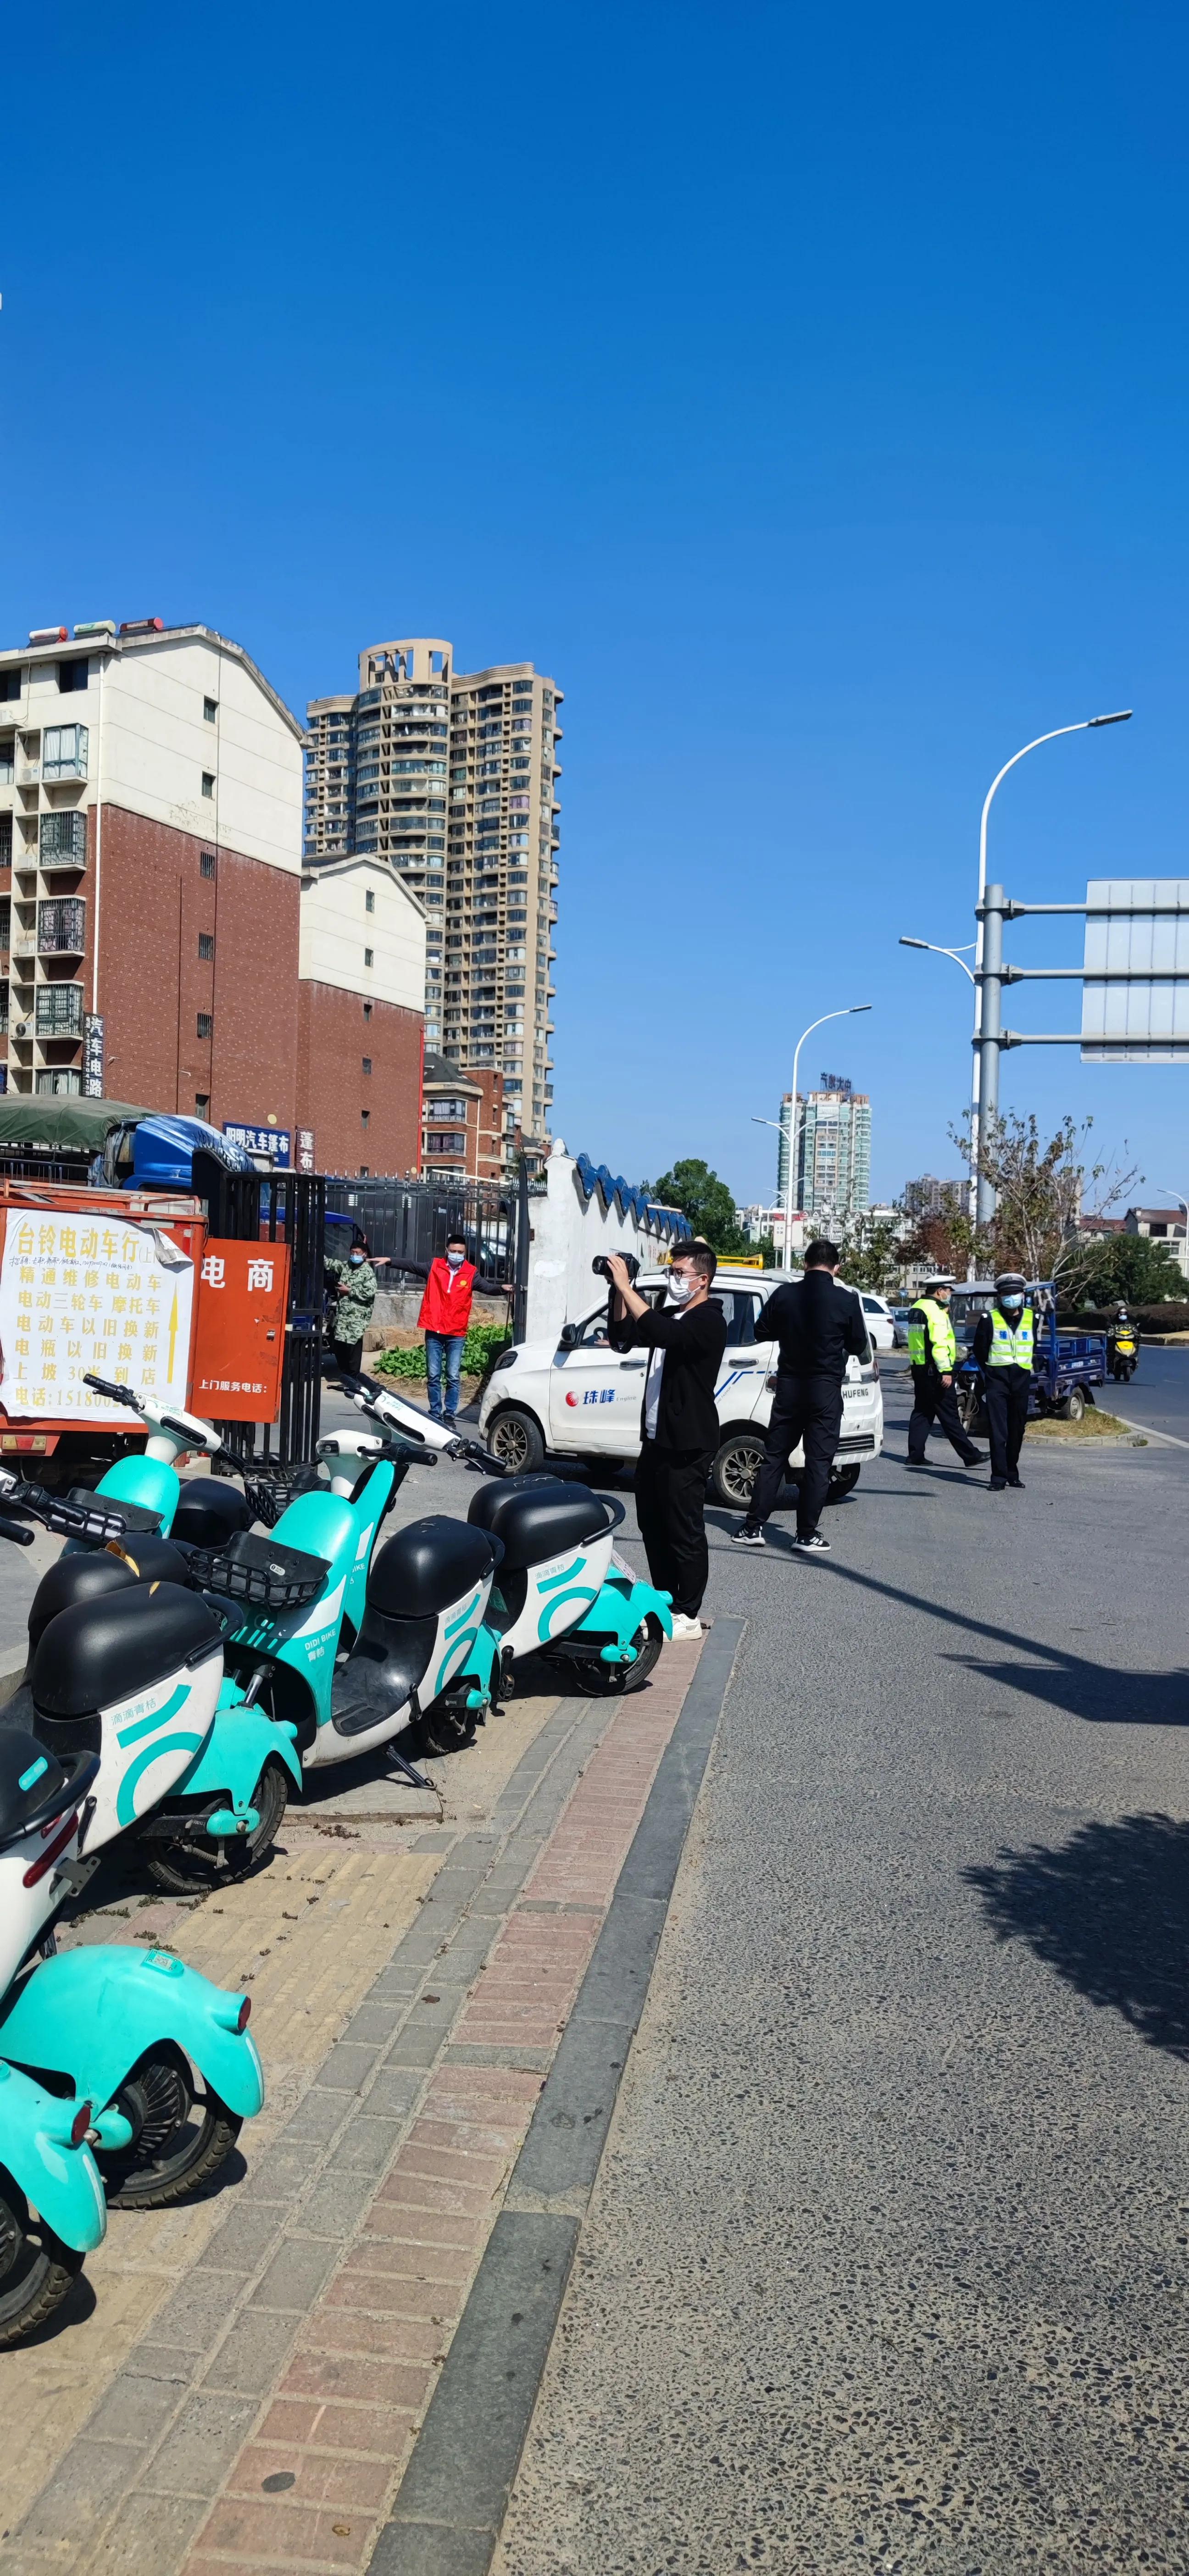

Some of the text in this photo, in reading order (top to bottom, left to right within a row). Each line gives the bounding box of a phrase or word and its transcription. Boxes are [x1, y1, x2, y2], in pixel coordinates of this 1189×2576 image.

[90, 1016, 103, 1098] 汽车电路
[18, 1222, 139, 1263] 台铃电动车行
[19, 1266, 161, 1292] 精通维修电动车
[18, 1290, 161, 1315] 电动三轮车 摩托车
[17, 1314, 159, 1339] 电动车以旧换新
[15, 1338, 157, 1362] 电瓶以旧换新
[199, 1379, 267, 1393] 上门服务电话:
[583, 1389, 616, 1405] 珠峰
[842, 1388, 869, 1399] HUFENG
[305, 1628, 336, 1650] DIDI BIKE
[307, 1646, 325, 1662] 青桔
[111, 1698, 156, 1725] 滴滴青桔
